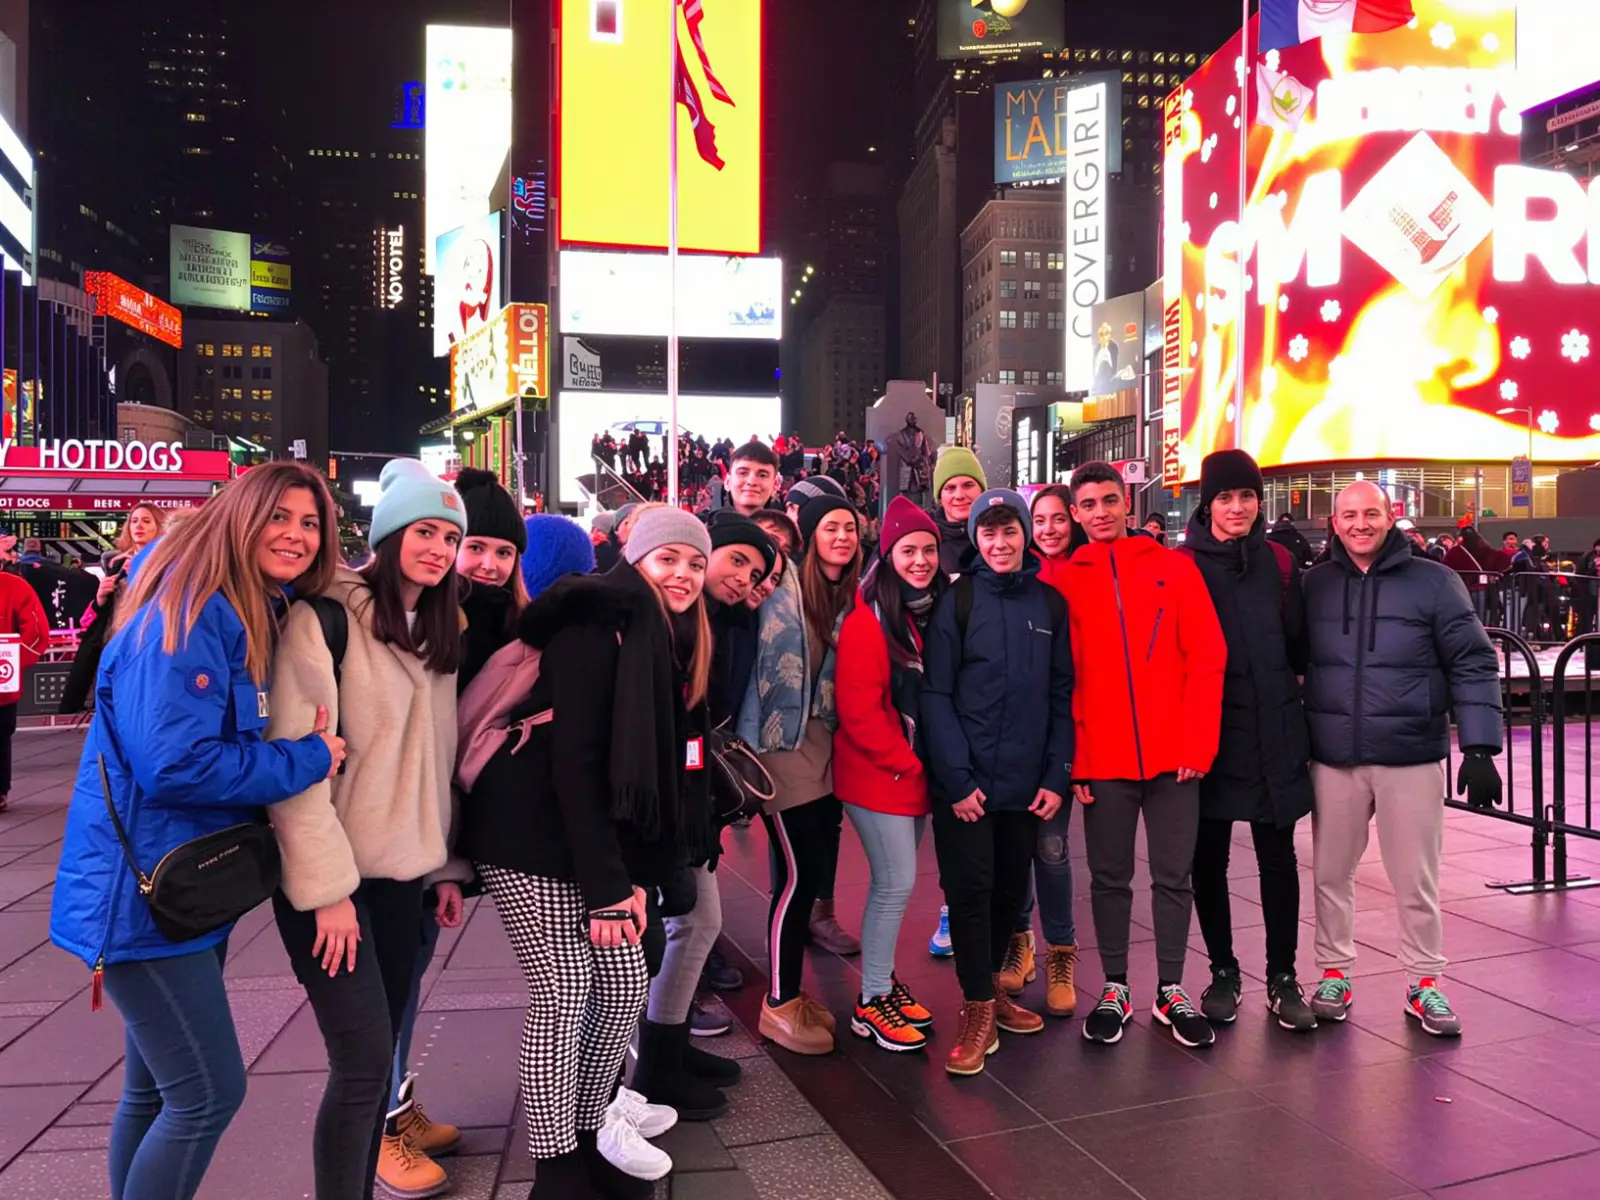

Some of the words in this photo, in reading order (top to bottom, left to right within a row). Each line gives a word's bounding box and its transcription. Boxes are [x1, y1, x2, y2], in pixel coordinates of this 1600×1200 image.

[1006, 87, 1045, 117] MY
[1072, 92, 1100, 338] COVERGIRL
[387, 224, 404, 309] NOVOTEL
[39, 438, 184, 471] HOTDOGS
